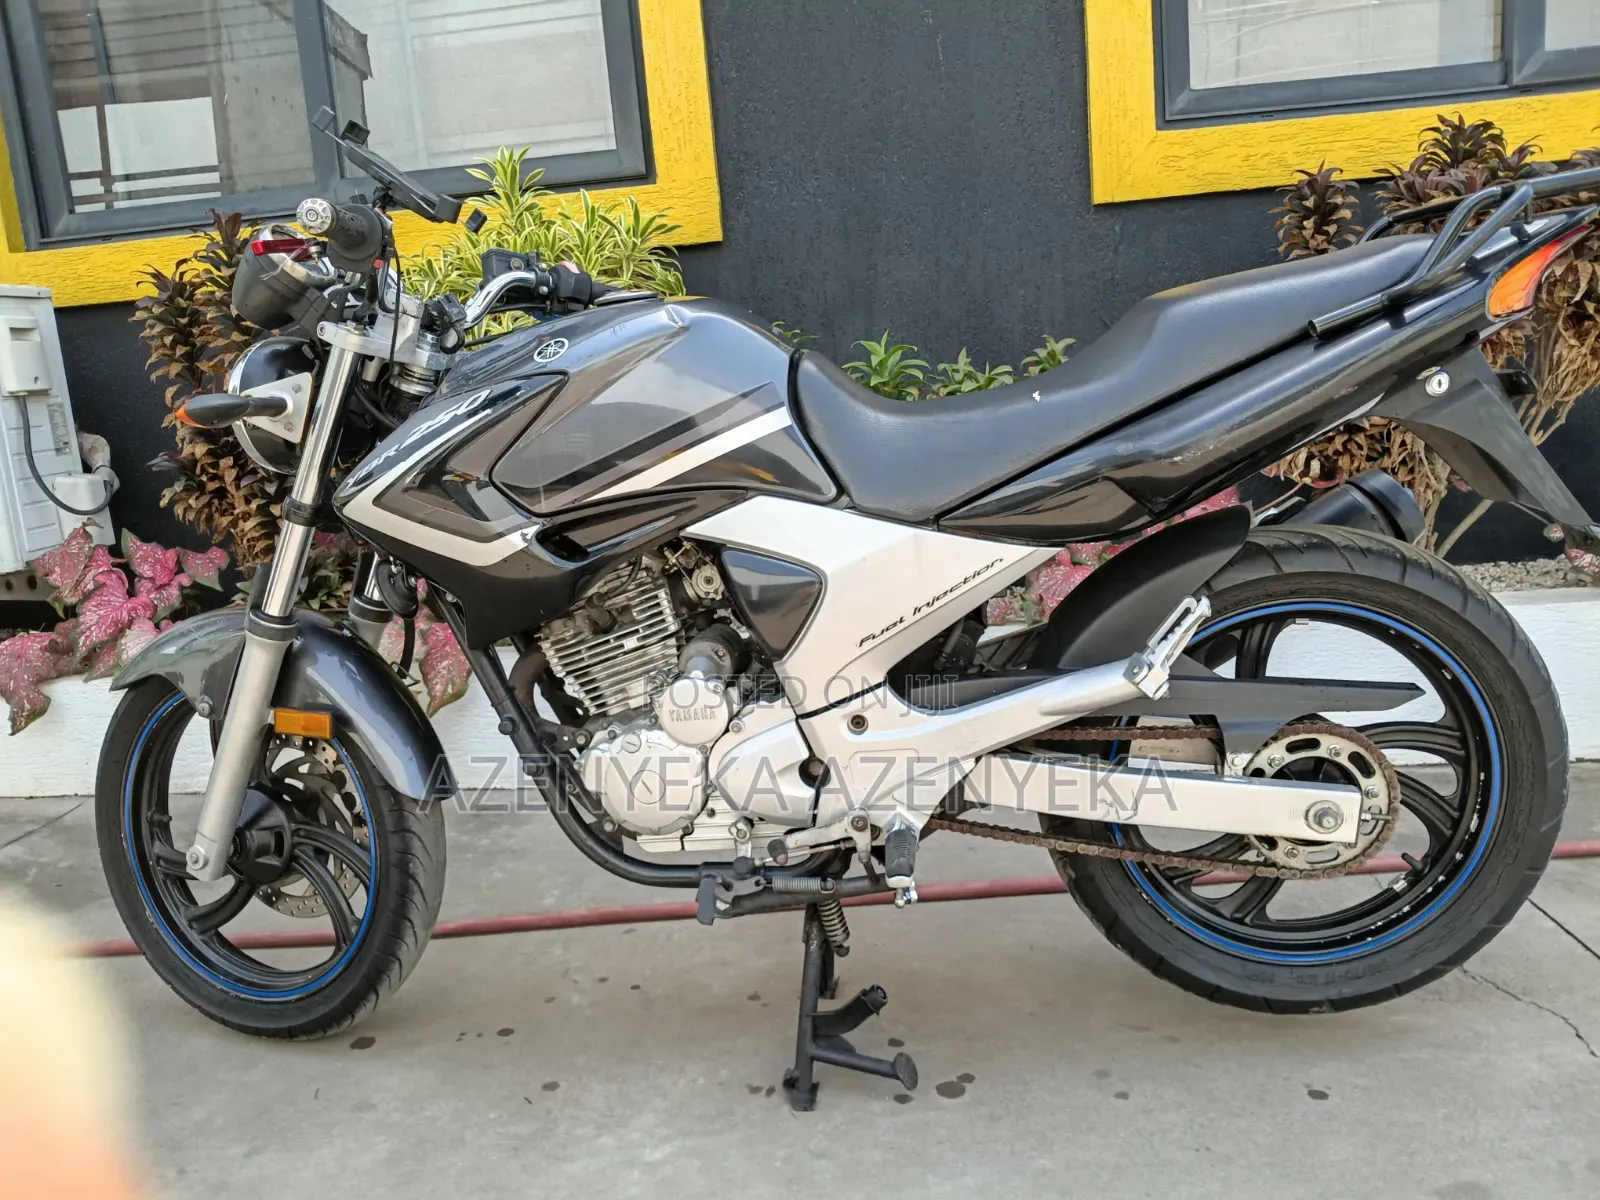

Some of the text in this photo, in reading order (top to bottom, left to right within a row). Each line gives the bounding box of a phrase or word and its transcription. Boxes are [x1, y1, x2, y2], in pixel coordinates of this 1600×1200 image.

[399, 389, 493, 450] 250
[858, 557, 1005, 648] Fuel Injection
[668, 708, 717, 723] YAMAHA
